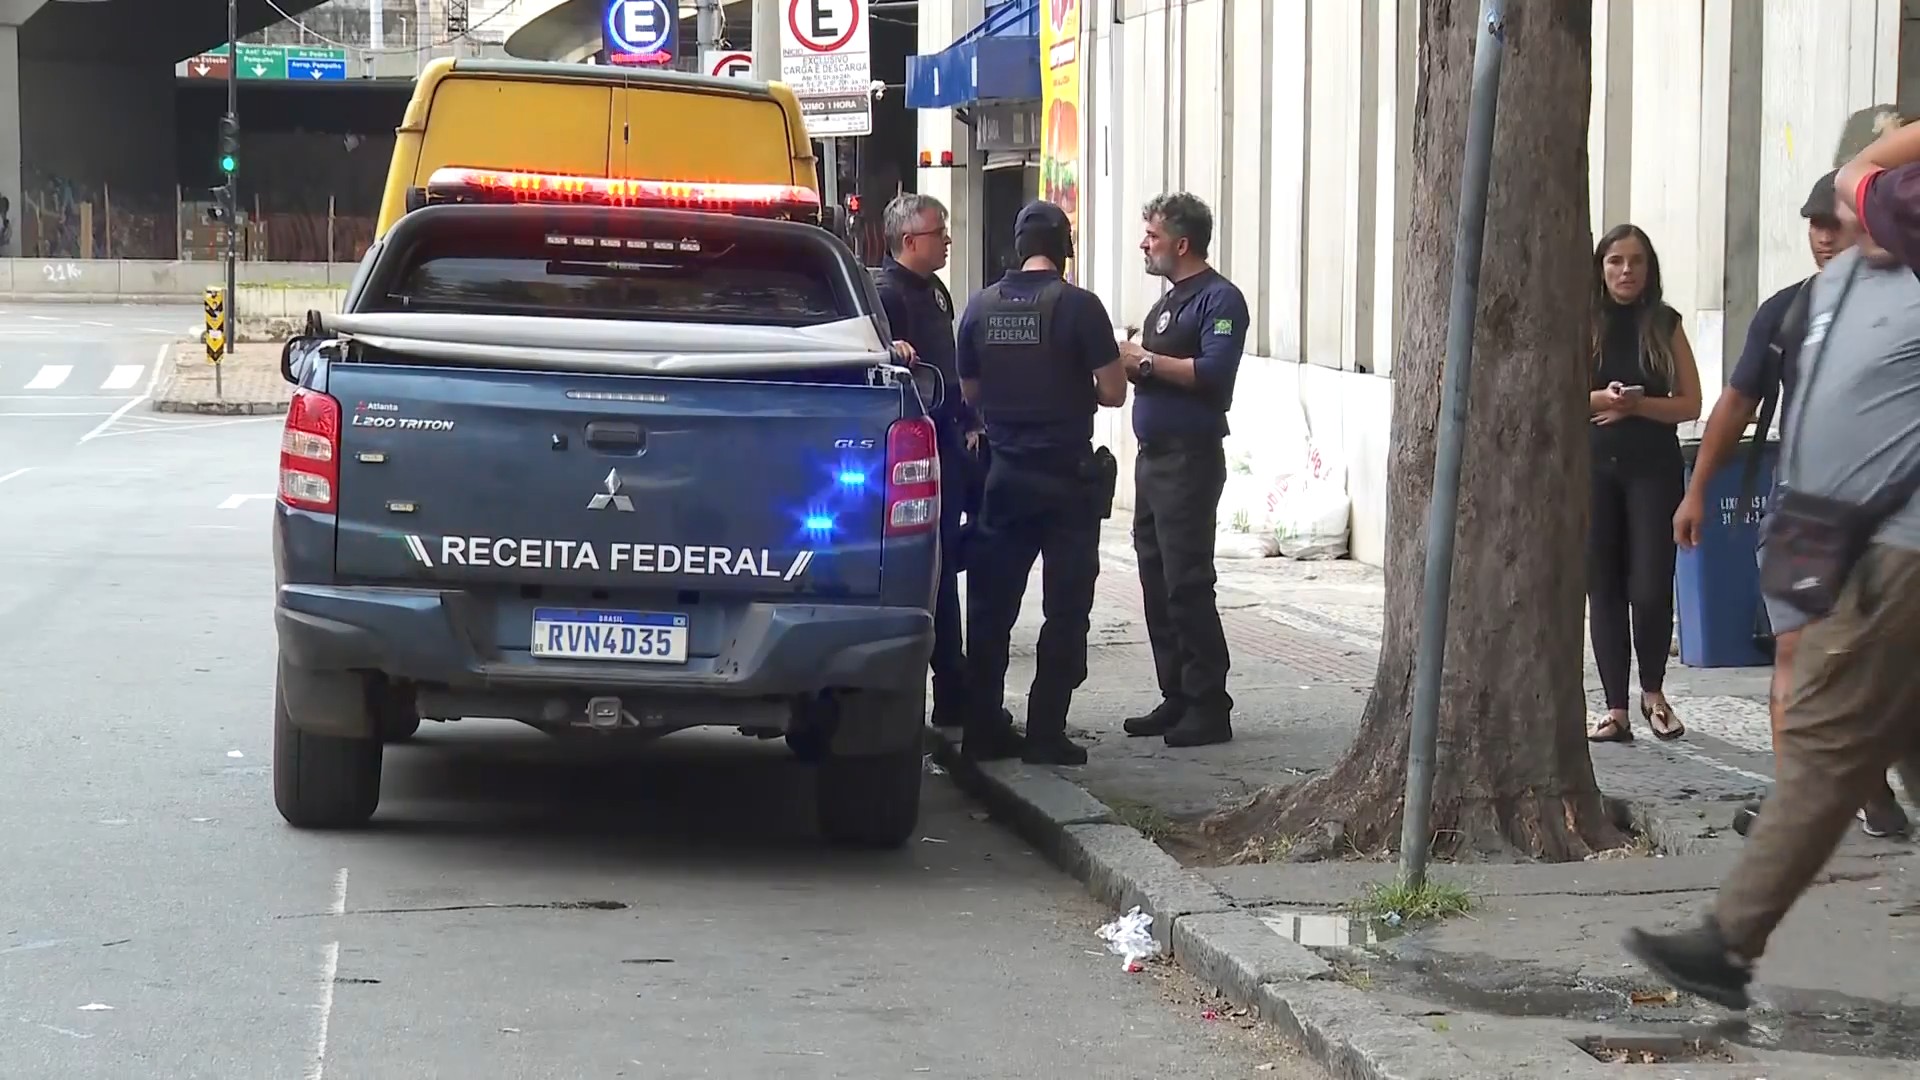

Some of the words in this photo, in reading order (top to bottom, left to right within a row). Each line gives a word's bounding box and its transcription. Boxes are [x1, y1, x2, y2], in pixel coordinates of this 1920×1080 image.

[624, 1, 657, 42] E
[803, 55, 849, 65] EXCLUSIVO
[783, 66, 813, 75] CARGA
[815, 65, 820, 73] E
[823, 63, 867, 73] DESCARGA
[833, 100, 857, 109] HORA
[989, 316, 1036, 327] RECEITA
[987, 329, 1038, 340] FEDERAL
[367, 402, 399, 412] Atlanta
[352, 414, 396, 428] L200
[399, 418, 454, 431] TRITON
[834, 439, 875, 449] GLS
[441, 535, 600, 570] RECEITA
[610, 543, 781, 577] FEDERAL
[598, 615, 624, 624] BRASIL
[548, 624, 672, 656] RVN4D35
